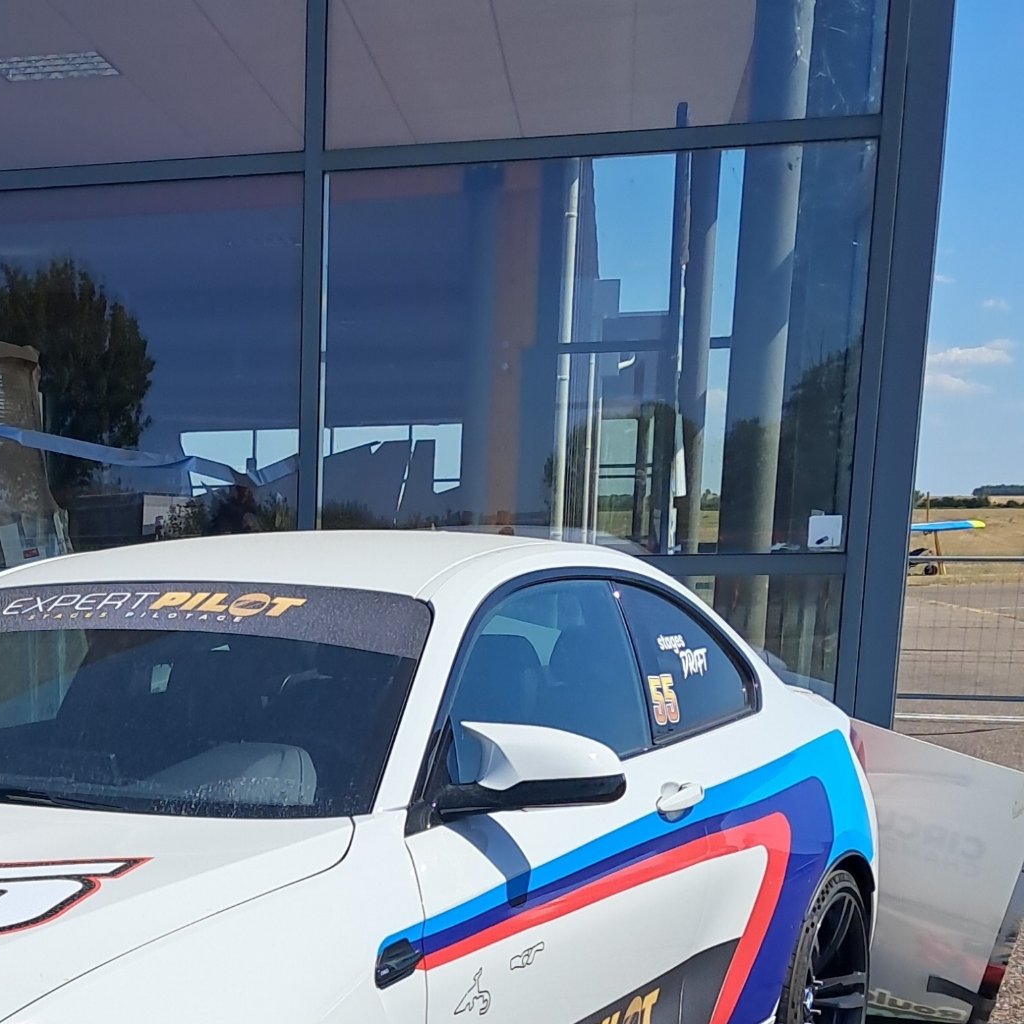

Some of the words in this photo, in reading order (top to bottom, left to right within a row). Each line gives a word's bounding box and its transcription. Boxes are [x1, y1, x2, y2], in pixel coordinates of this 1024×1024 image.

[27, 611, 109, 622] STAGES
[125, 611, 243, 624] PILOTAGE
[679, 648, 708, 680] DRIFT
[647, 673, 680, 726] 55
